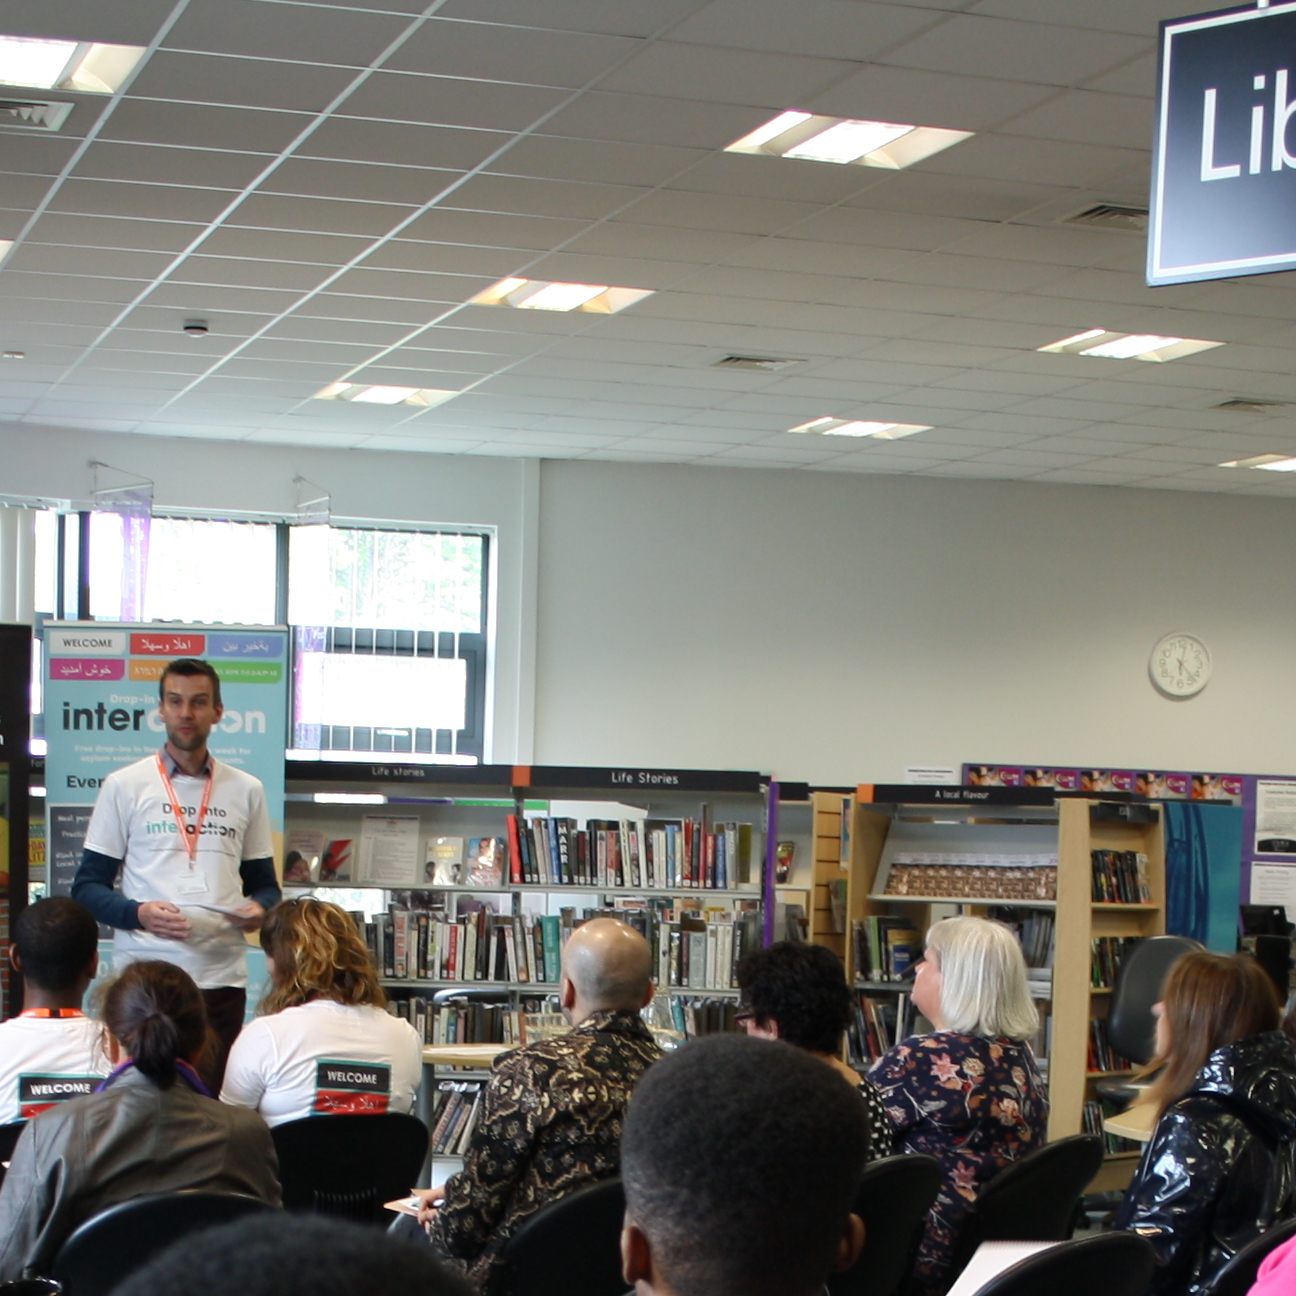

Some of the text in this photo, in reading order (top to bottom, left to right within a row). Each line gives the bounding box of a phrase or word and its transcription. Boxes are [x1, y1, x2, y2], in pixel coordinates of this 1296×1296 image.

[63, 638, 113, 649] WELCOME
[109, 693, 154, 706] Drop-in
[62, 702, 267, 734] interaon
[371, 765, 426, 778] Life stories
[611, 771, 679, 786] Life Stories
[66, 775, 104, 789] Ever
[934, 789, 990, 799] A local flavour
[162, 802, 227, 819] Dop nto
[146, 820, 237, 839] inteaction
[556, 824, 570, 865] MARR
[327, 1070, 377, 1085] WELCOME
[29, 1082, 91, 1096] WELCOME
